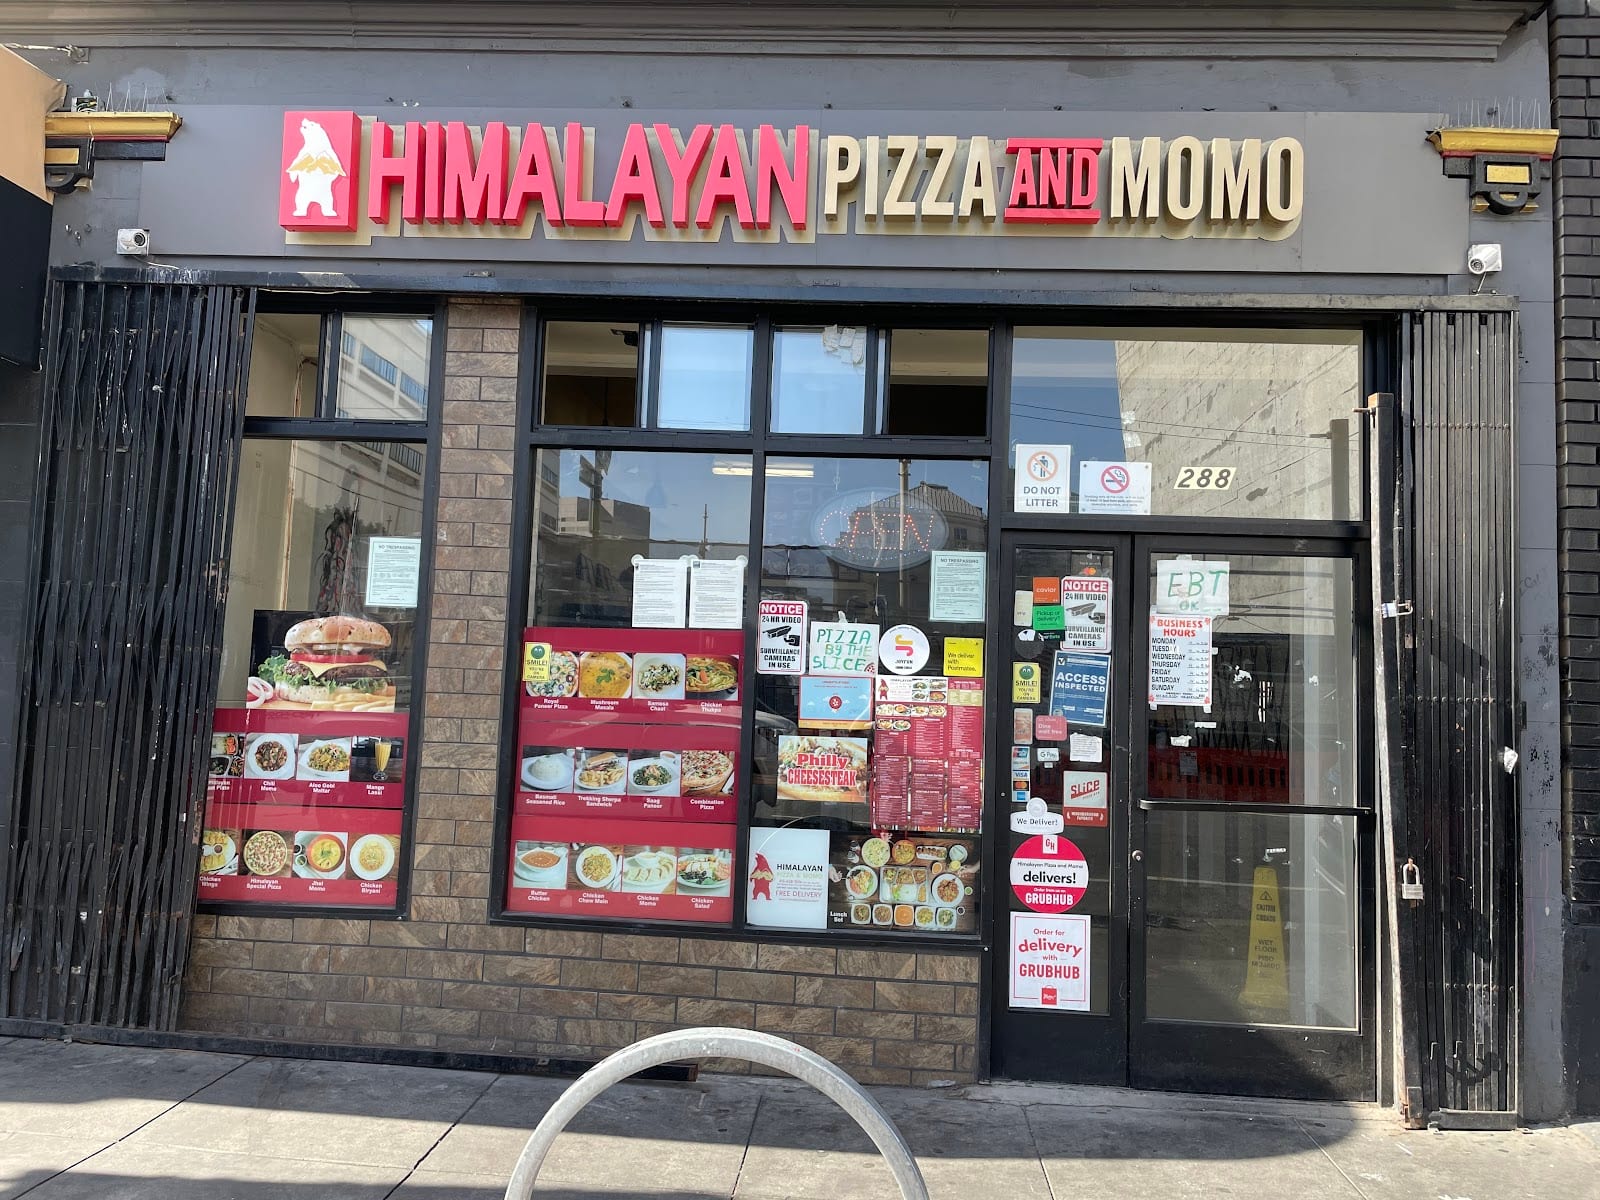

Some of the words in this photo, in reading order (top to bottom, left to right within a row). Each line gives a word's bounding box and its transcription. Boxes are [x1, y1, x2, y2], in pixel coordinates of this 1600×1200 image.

[369, 121, 809, 231] HIMALAYAN
[824, 135, 996, 223] PIZZA
[1006, 144, 1099, 211] AND
[1109, 135, 1304, 226] MOMO
[1177, 468, 1232, 489] 288
[1023, 486, 1039, 495] DO
[1040, 486, 1061, 496] NOT
[1025, 498, 1059, 508] LITTER
[1064, 581, 1108, 591] NOTICE
[1167, 570, 1228, 598] EBT
[1065, 592, 1074, 600] 24
[1085, 593, 1107, 601] VIDEO
[761, 603, 803, 615] NOTICE
[1179, 600, 1200, 611] OK
[781, 616, 802, 624] VIDEO
[1157, 619, 1203, 629] BUSINESS
[816, 628, 872, 645] PIZZA
[1163, 628, 1196, 637] HOURS
[760, 647, 801, 656] SURVEILLANCE
[847, 644, 873, 656] THE
[813, 655, 866, 672] SLICE
[1151, 660, 1181, 668] THURSDAY
[1055, 671, 1106, 685] ACCESS
[1055, 681, 1106, 692] INSPECTED
[797, 752, 849, 770] Philly
[787, 768, 857, 787] CHEESESTEAK
[1029, 818, 1058, 826] Deliver!
[776, 863, 823, 872] HIMALAYAN
[1022, 870, 1077, 884] delivers!
[792, 890, 822, 898] DELIVERY
[1025, 892, 1074, 906] GRUBHUB
[1033, 928, 1053, 936] Order
[1018, 938, 1083, 958] delivery
[1019, 963, 1080, 980] GRUBHUB
